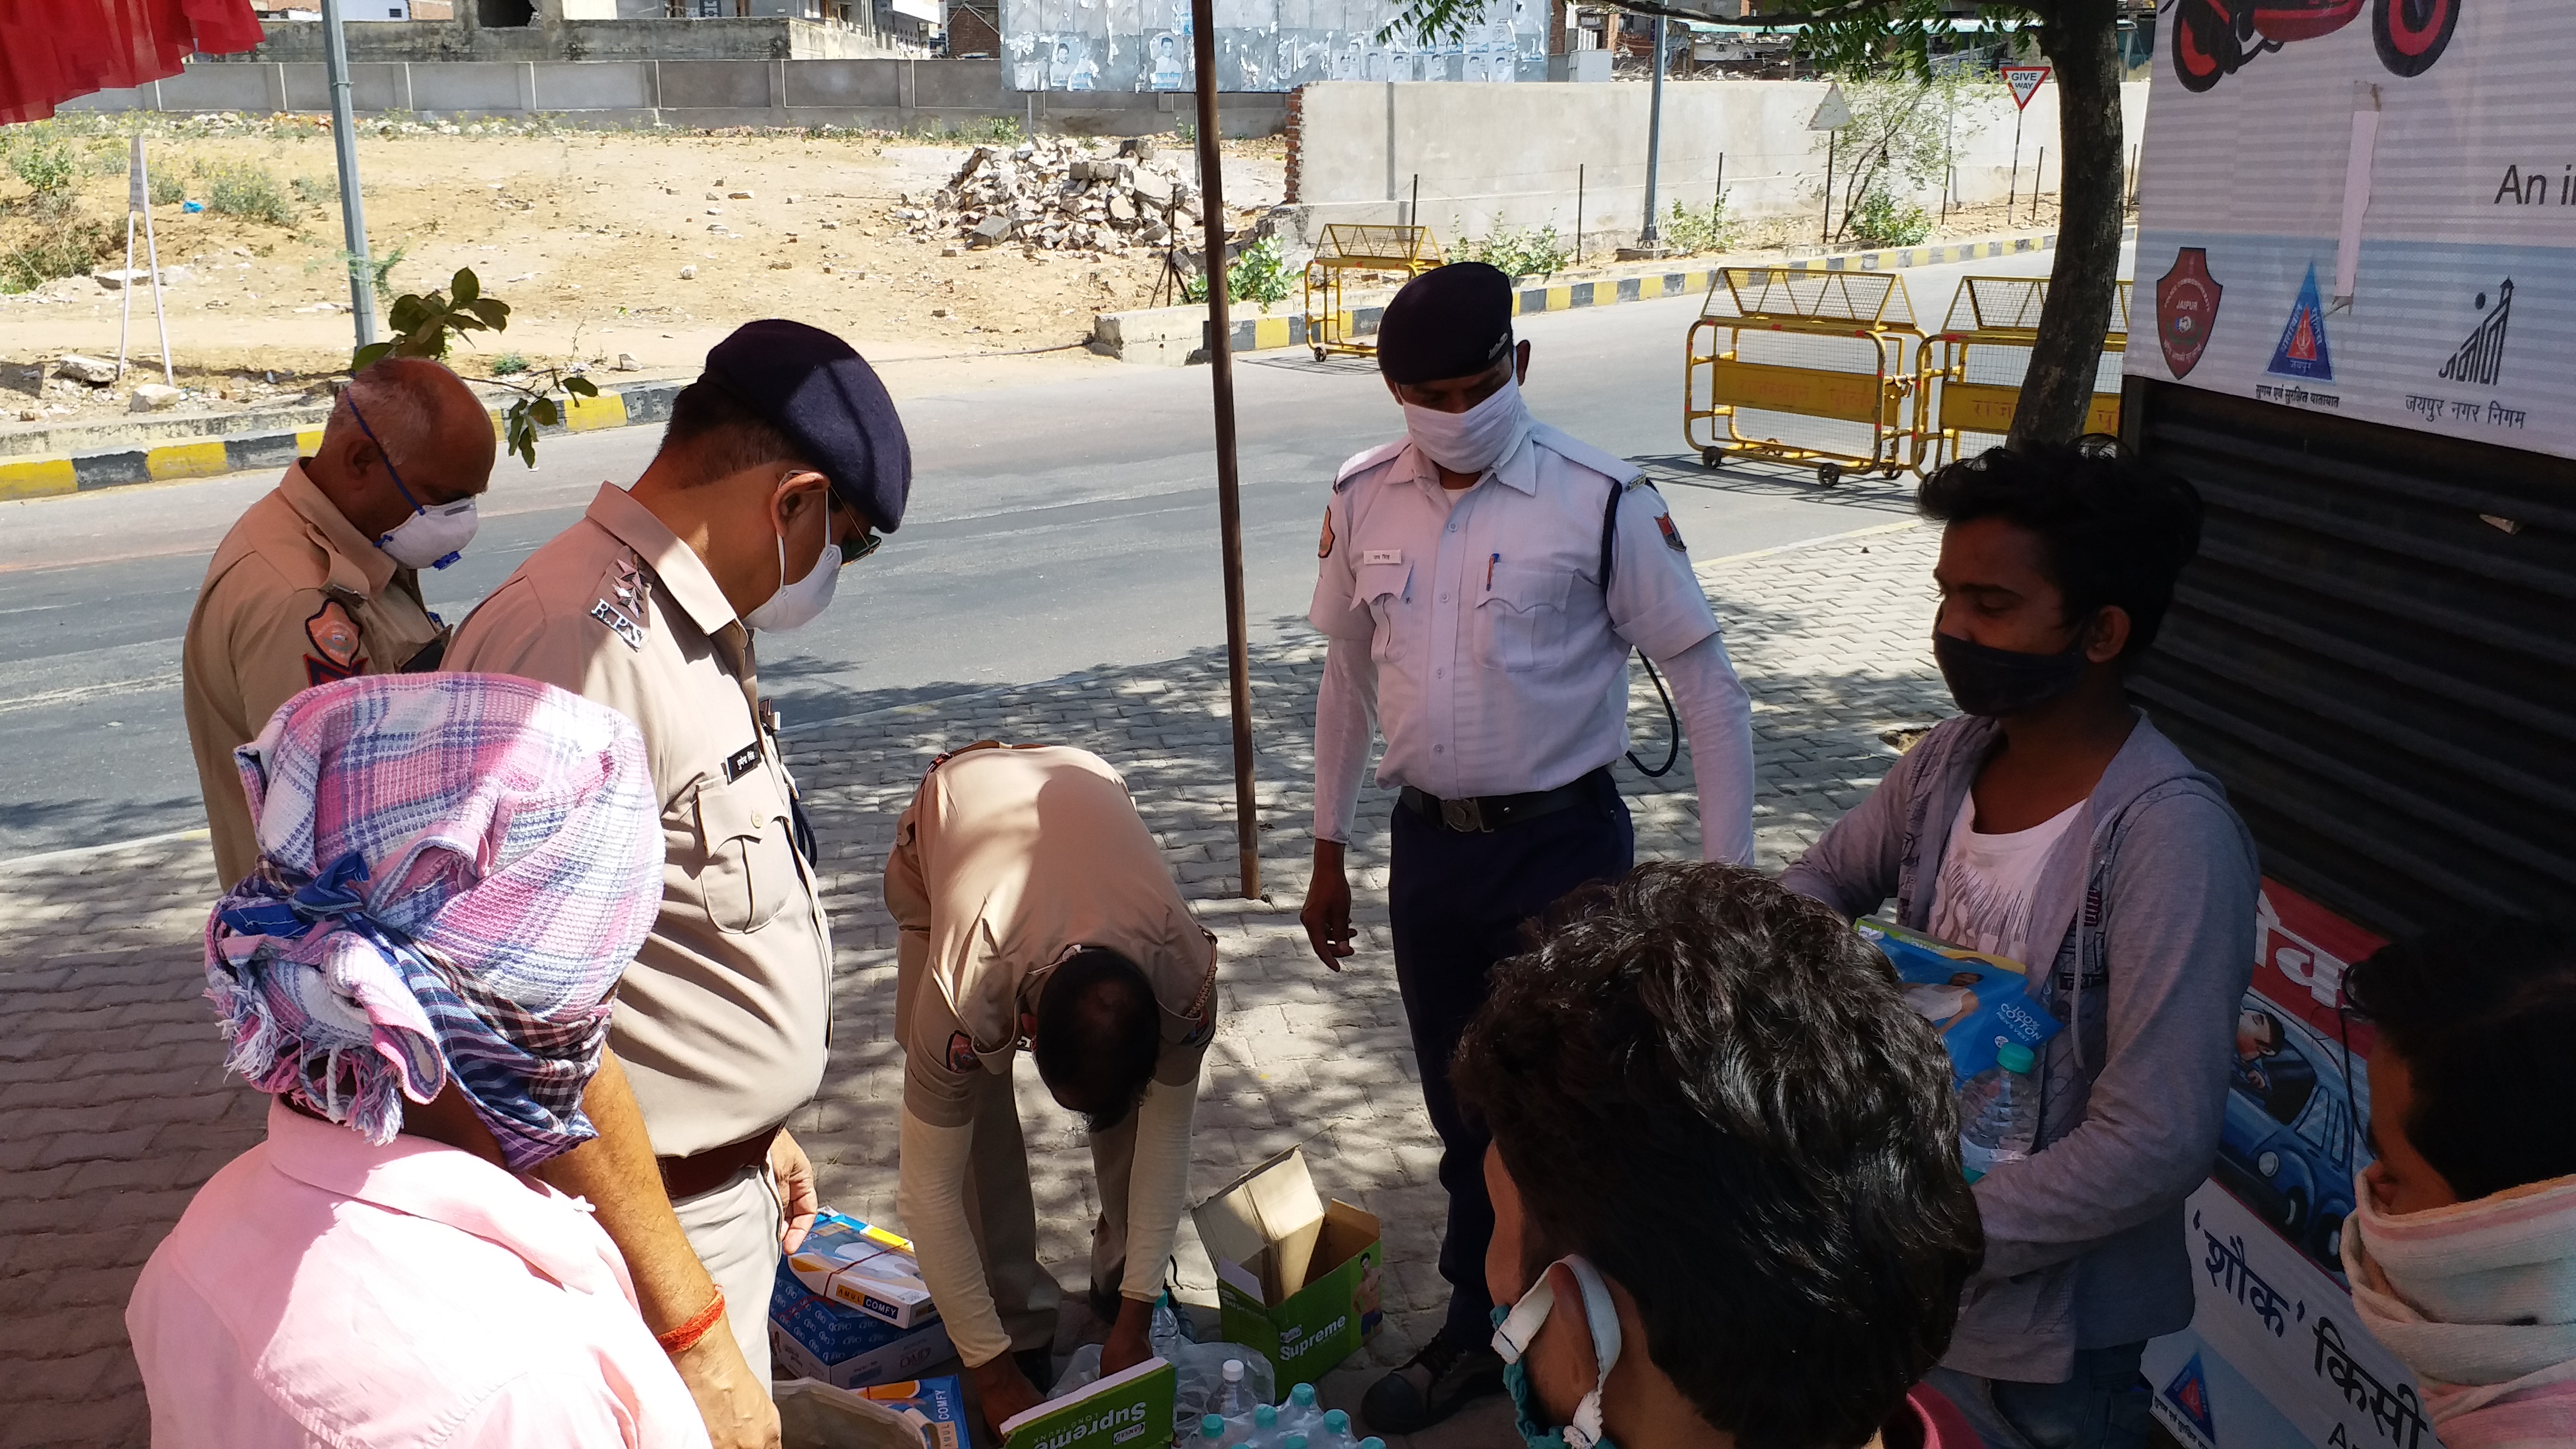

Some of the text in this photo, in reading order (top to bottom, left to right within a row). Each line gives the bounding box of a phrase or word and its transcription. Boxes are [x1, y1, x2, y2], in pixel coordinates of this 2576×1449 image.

[2494, 164, 2576, 205] An i
[2176, 300, 2198, 311] JAIPUR
[2405, 395, 2526, 429] जयपुर नगर निगम
[2001, 1003, 2042, 1040] COTTON
[2012, 1006, 2040, 1030] 100%
[2014, 1029, 2030, 1041] VEST
[839, 1288, 896, 1317] AMUL COMFY
[1280, 1315, 1346, 1361] Supreme
[2312, 1317, 2429, 1449] किसी
[935, 1390, 950, 1420] COMFY
[1034, 1413, 1098, 1443] LONG TRUNK
[2327, 1421, 2360, 1449] A
